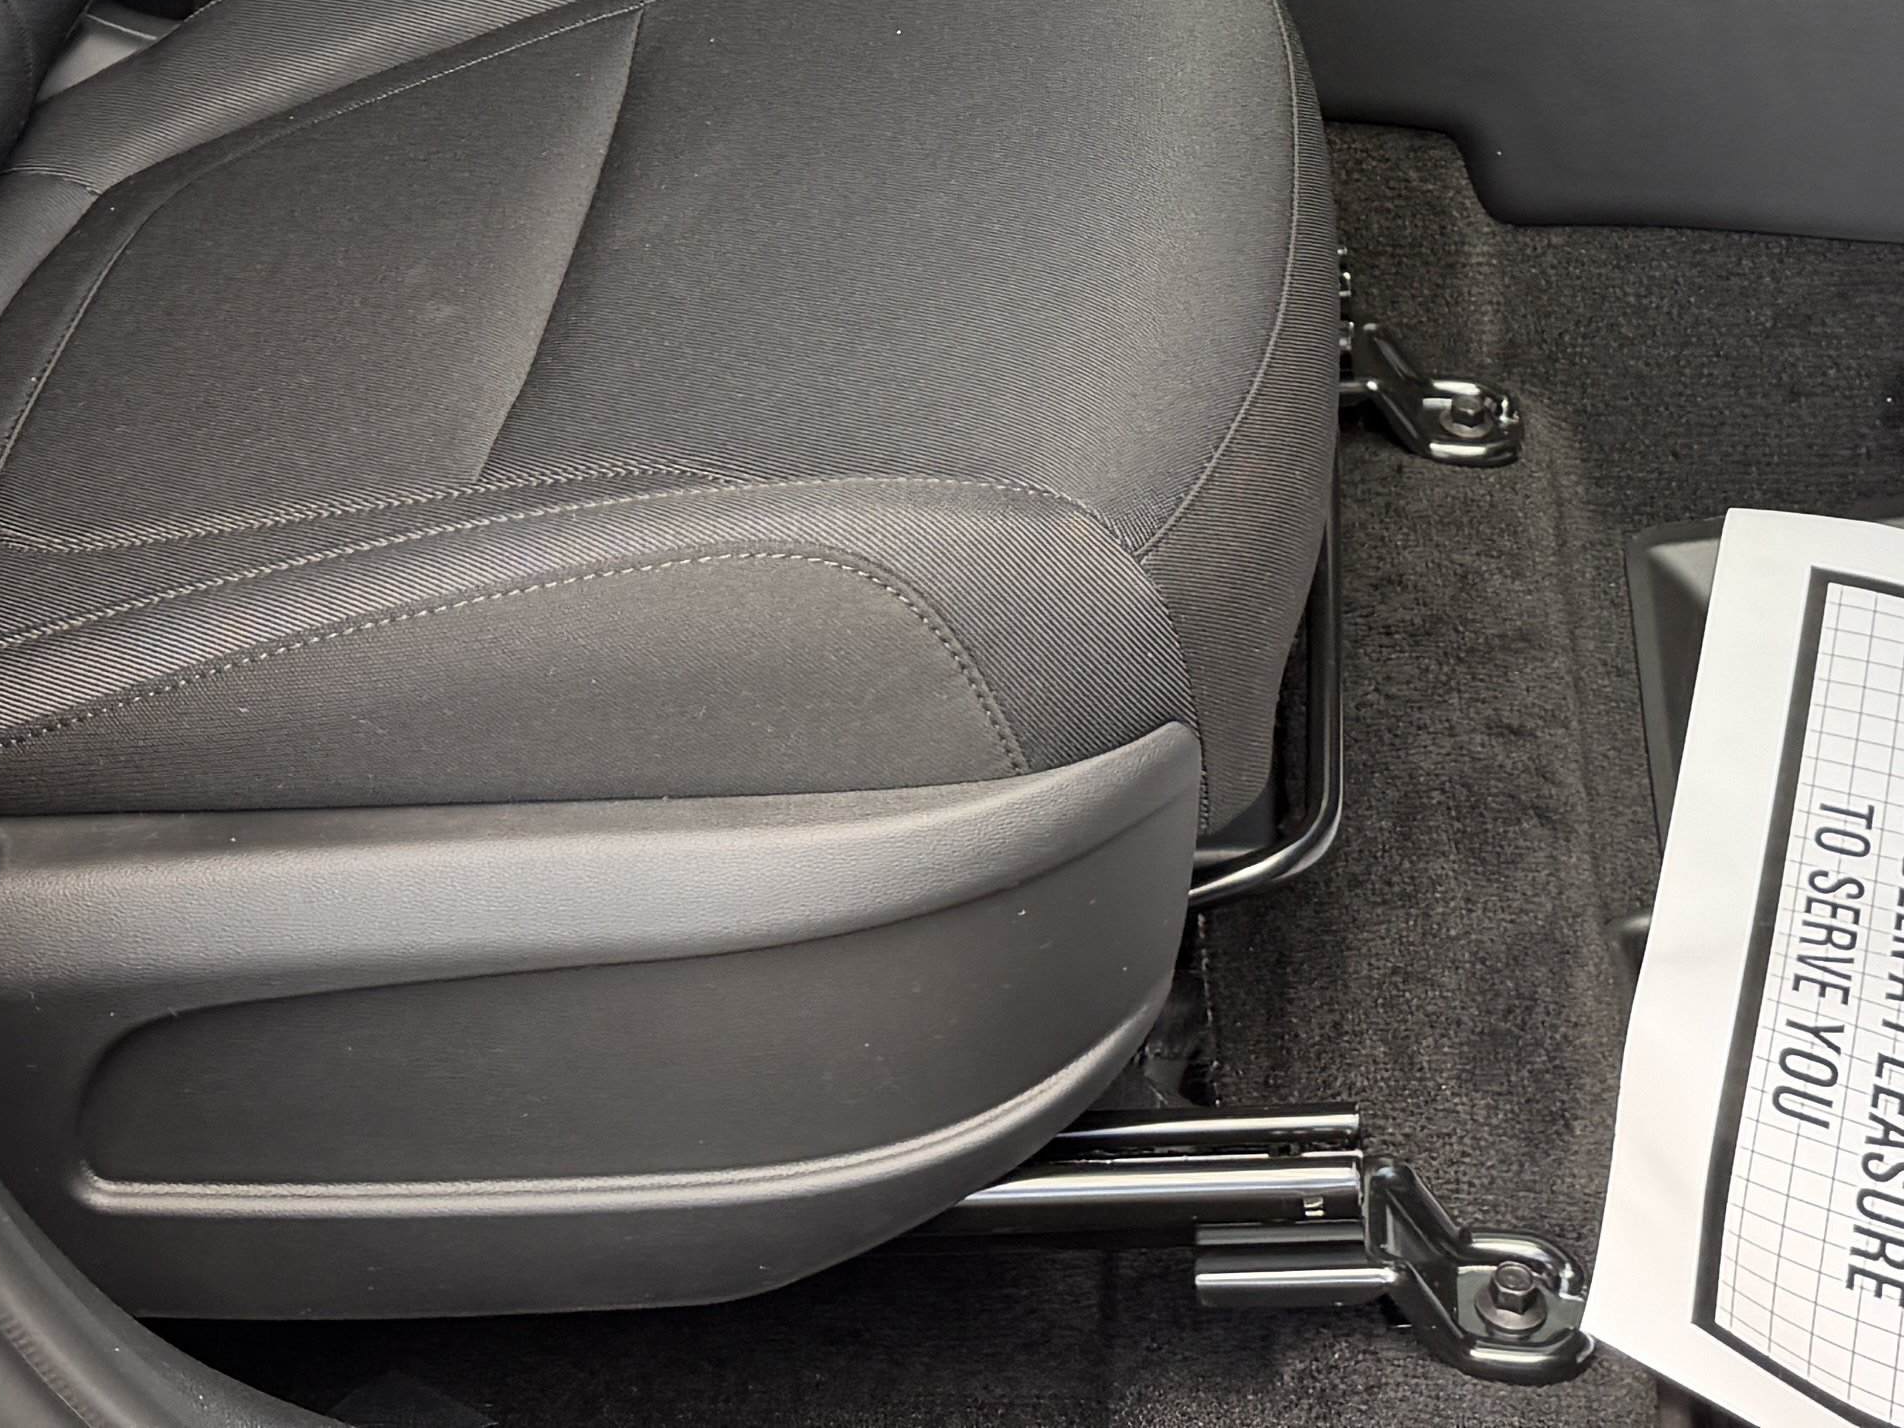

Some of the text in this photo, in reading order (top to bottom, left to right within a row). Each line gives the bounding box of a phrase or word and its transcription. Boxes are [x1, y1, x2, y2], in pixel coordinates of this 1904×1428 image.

[1771, 802, 1876, 1130] TO SERVE YOU
